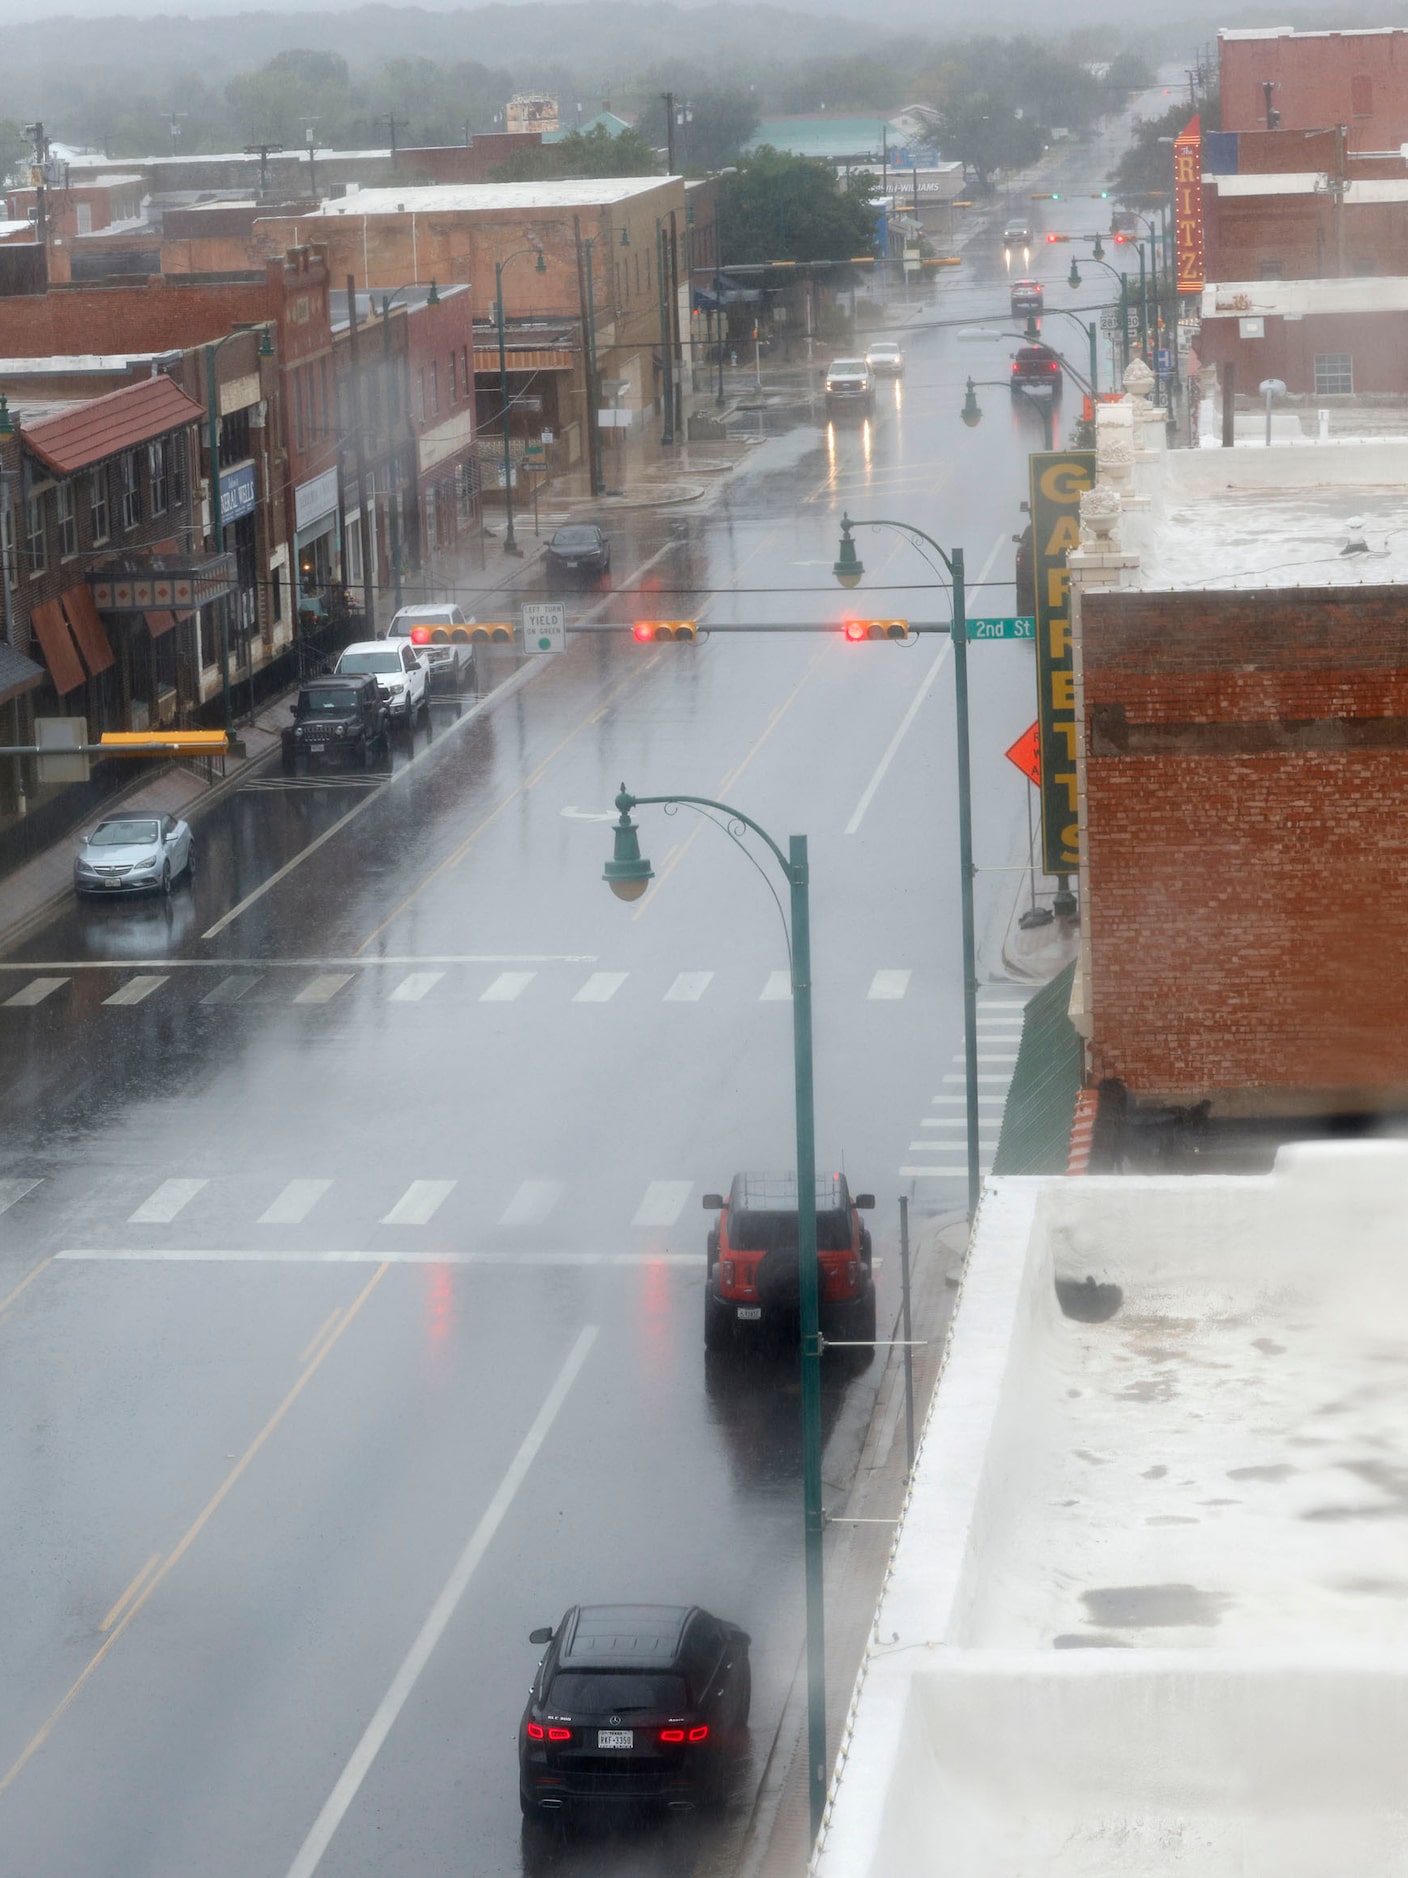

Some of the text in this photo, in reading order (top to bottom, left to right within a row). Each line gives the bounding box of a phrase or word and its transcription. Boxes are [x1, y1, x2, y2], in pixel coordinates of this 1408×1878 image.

[1178, 157, 1197, 279] RITZ
[1101, 318, 1116, 327] 281
[529, 615, 558, 625] YIELD
[539, 627, 561, 635] GREEN
[976, 619, 1030, 637] 2nd St
